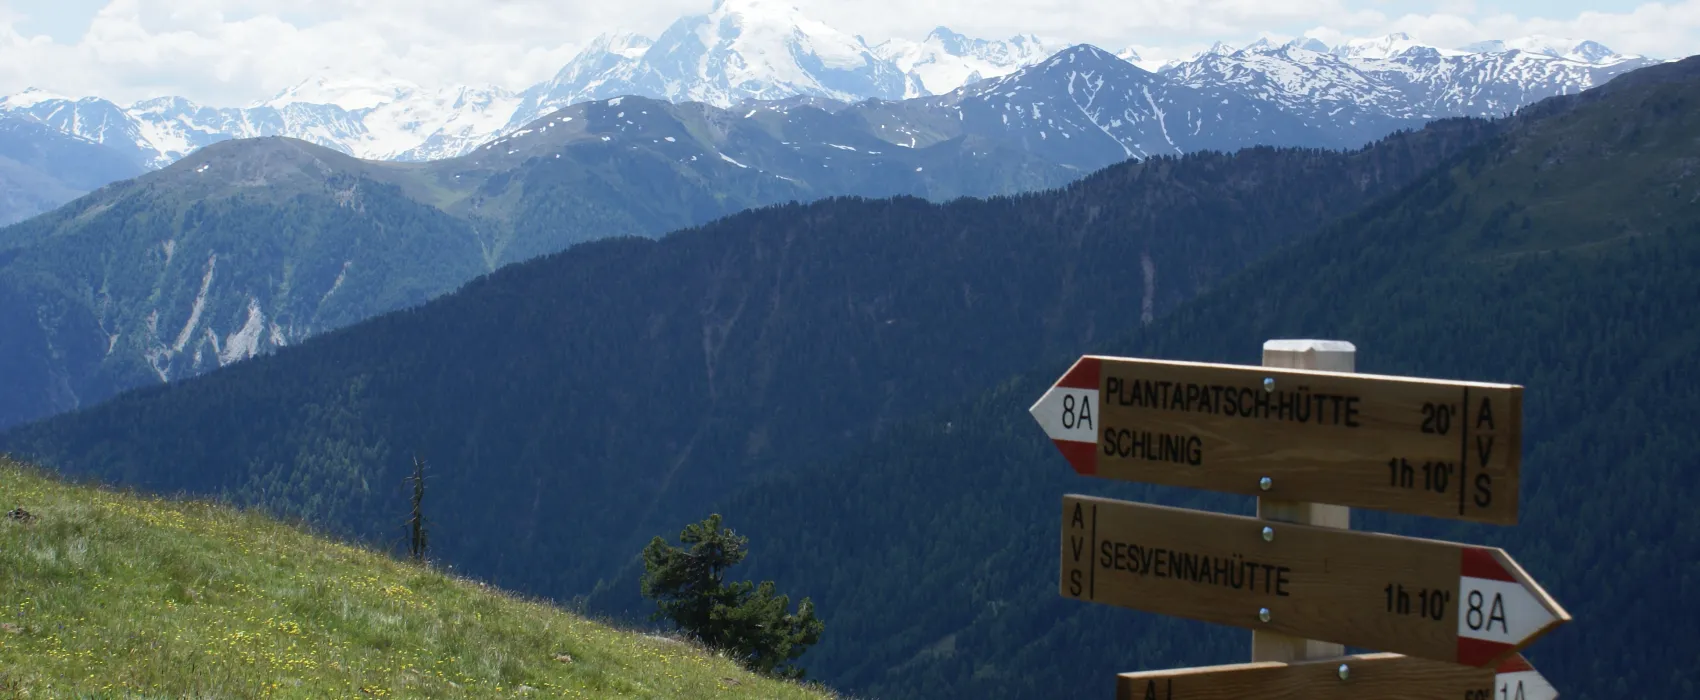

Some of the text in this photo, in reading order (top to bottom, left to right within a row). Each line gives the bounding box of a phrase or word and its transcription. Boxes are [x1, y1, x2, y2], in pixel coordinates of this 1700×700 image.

[1062, 394, 1093, 430] 8A
[1105, 377, 1360, 428] PLANTAPATSCH-HÜTTE
[1420, 402, 1456, 435] 20'
[1103, 427, 1202, 466] SCHLINIG
[1387, 457, 1414, 488] 1h
[1100, 540, 1291, 597] SESVENNAHÜTTE
[1383, 583, 1411, 616] 1h
[1466, 589, 1509, 634] 8A
